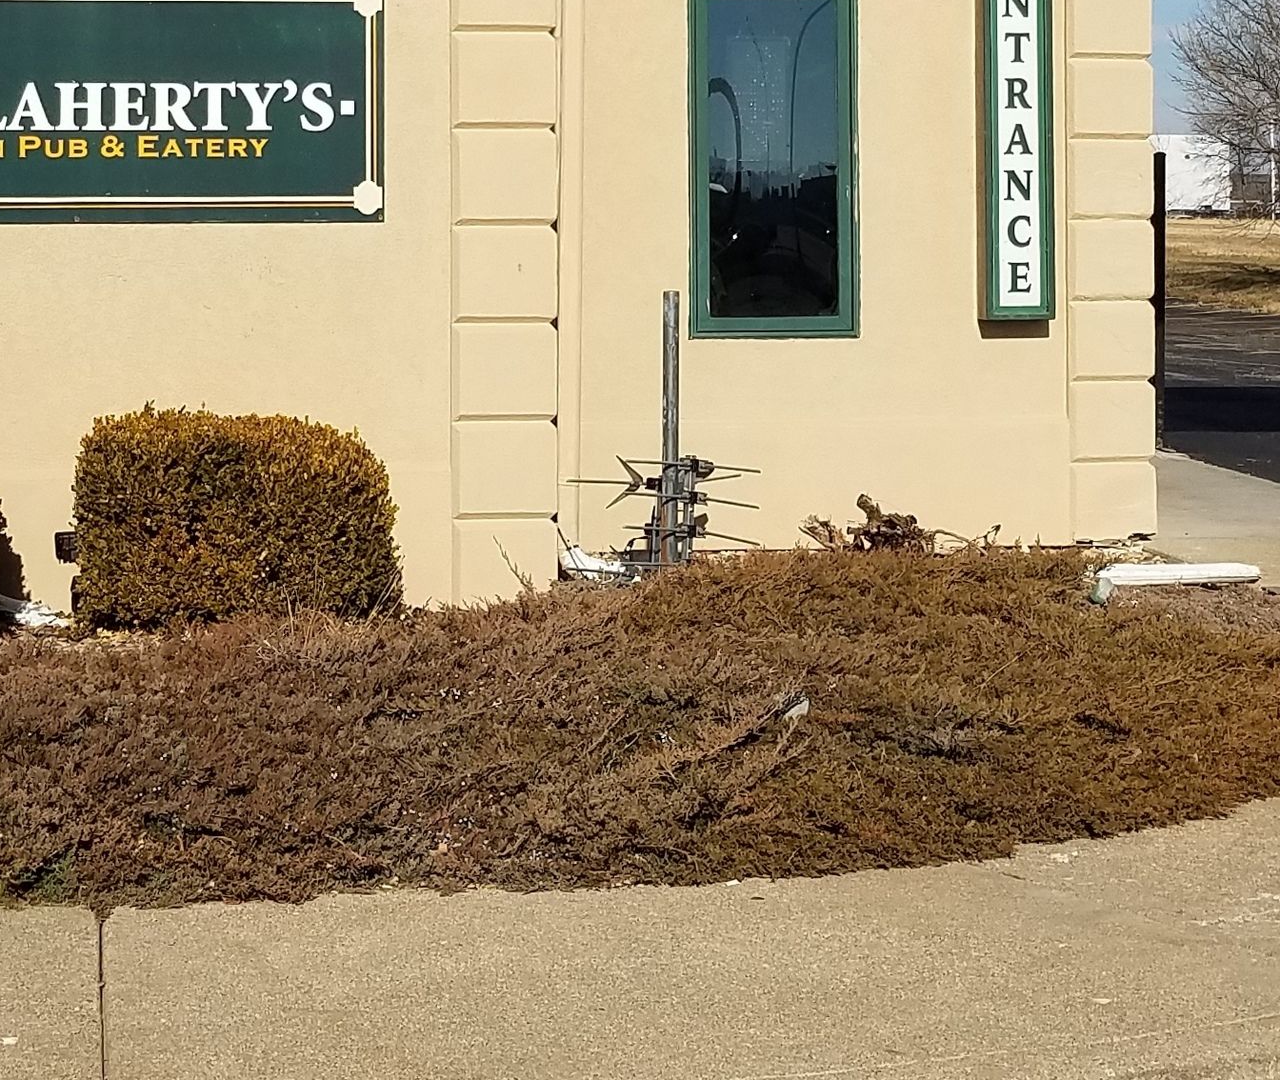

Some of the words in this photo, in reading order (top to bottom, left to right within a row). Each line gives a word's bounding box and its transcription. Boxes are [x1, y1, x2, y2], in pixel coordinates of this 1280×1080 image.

[18, 135, 89, 159] PUB
[100, 134, 125, 158] &
[137, 134, 270, 159] EATERY
